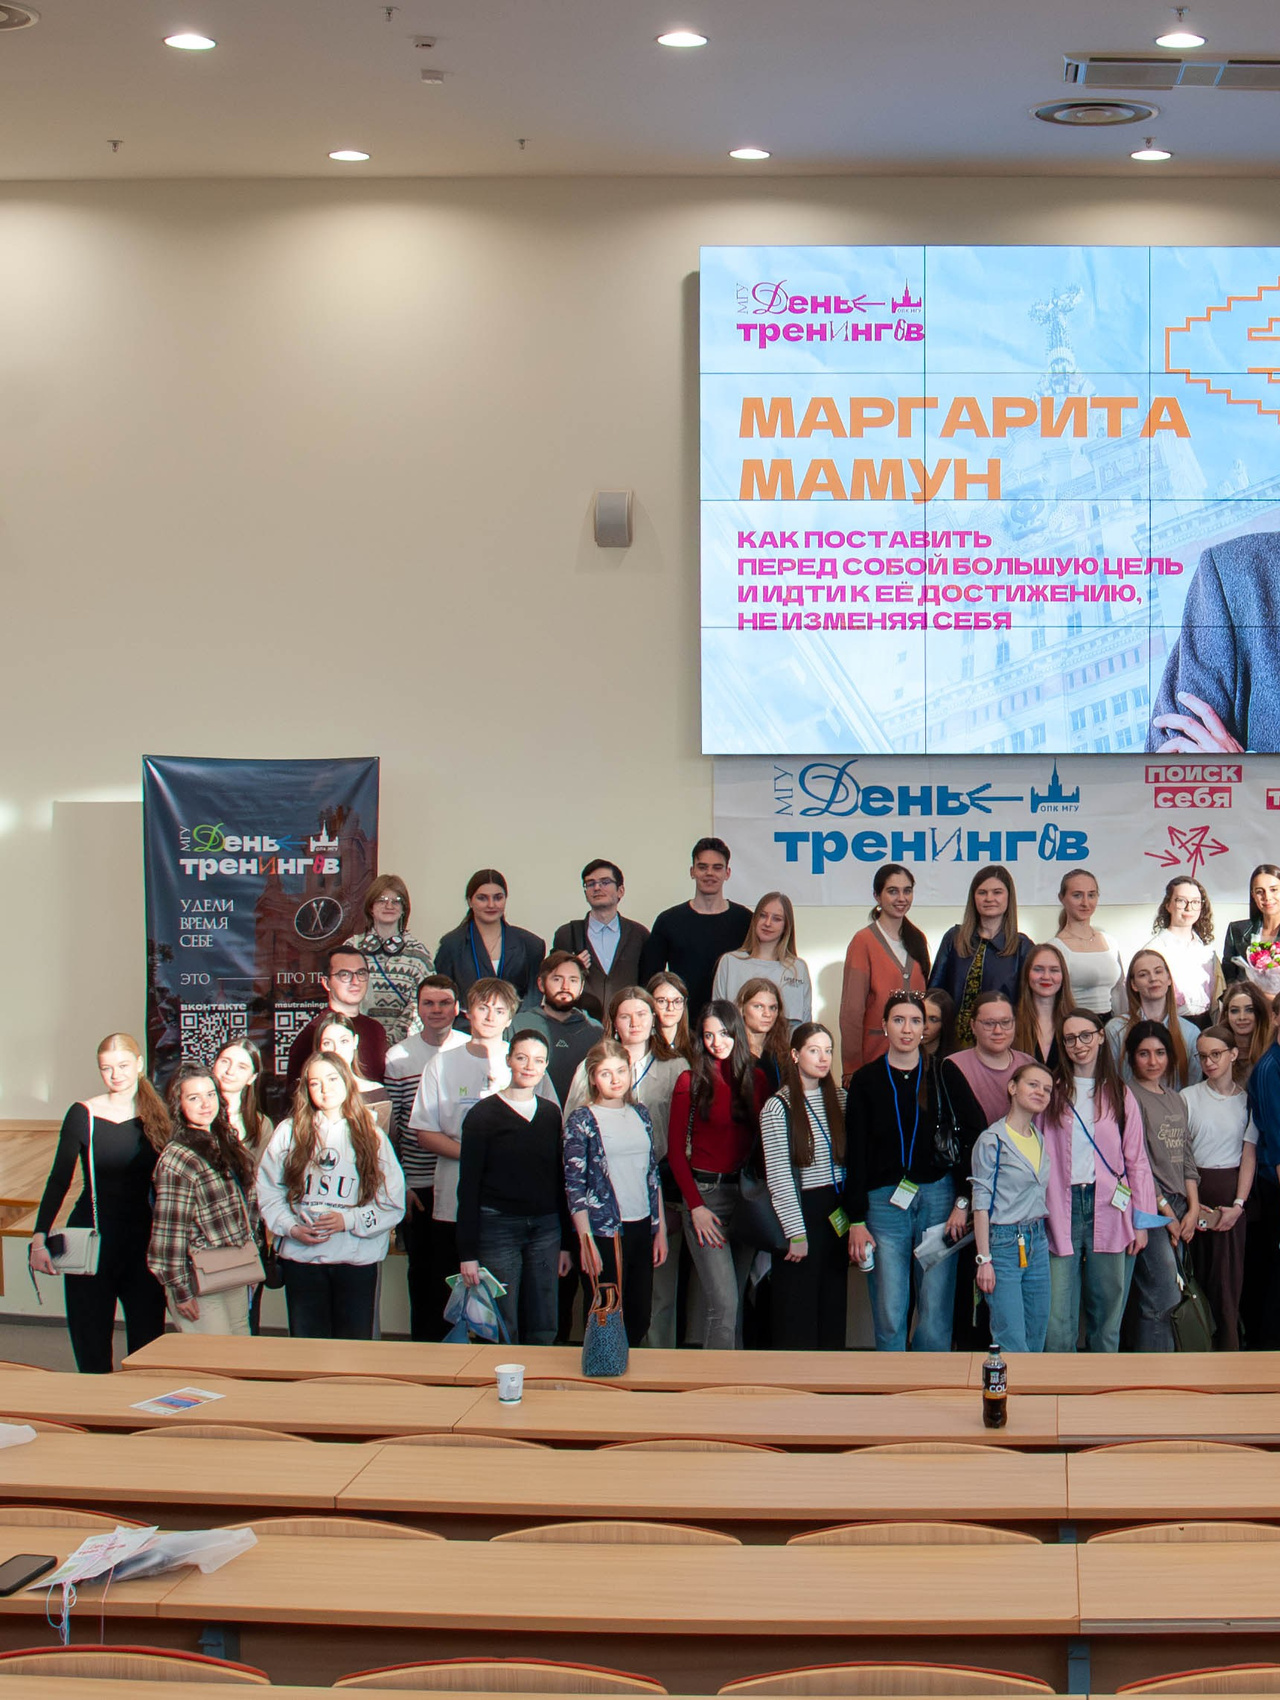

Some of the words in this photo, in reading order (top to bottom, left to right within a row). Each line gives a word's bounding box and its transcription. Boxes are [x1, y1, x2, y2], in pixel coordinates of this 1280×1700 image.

[737, 283, 749, 315] МГУ
[752, 279, 854, 315] День
[738, 396, 1192, 438] МАРГАРИТА
[738, 458, 1001, 504] МАМУН
[737, 531, 799, 549] КАК
[804, 530, 992, 549] ПОСТАВИТЬ
[738, 558, 838, 579] ПЕРЕД
[842, 553, 948, 576] СОБОЙ
[952, 557, 1099, 577] БОЛЬШУЮ
[1103, 557, 1184, 579] ЦЕЛЬ
[738, 585, 758, 603] И
[762, 585, 846, 606] ИДТИ
[851, 585, 870, 603] К
[875, 581, 914, 603] ЕЁ
[917, 584, 1142, 606] ДОСТИЖЕНИЮ,
[738, 612, 778, 631] НЕ
[782, 612, 928, 631] ИЗМЕНЯЯ
[932, 611, 1012, 631] СЕБЯ
[773, 765, 794, 816] МГУ
[798, 759, 971, 817] День
[1156, 788, 1231, 808] себя
[180, 826, 191, 852] МГУ
[192, 823, 280, 852] День
[180, 899, 234, 913] УДЕЛИ
[180, 917, 228, 930] ВРЕМЯ
[180, 934, 213, 948] СЕБЕ
[180, 973, 211, 985] ЭТО
[277, 972, 305, 984] ПРО
[989, 1384, 1007, 1393] COL
